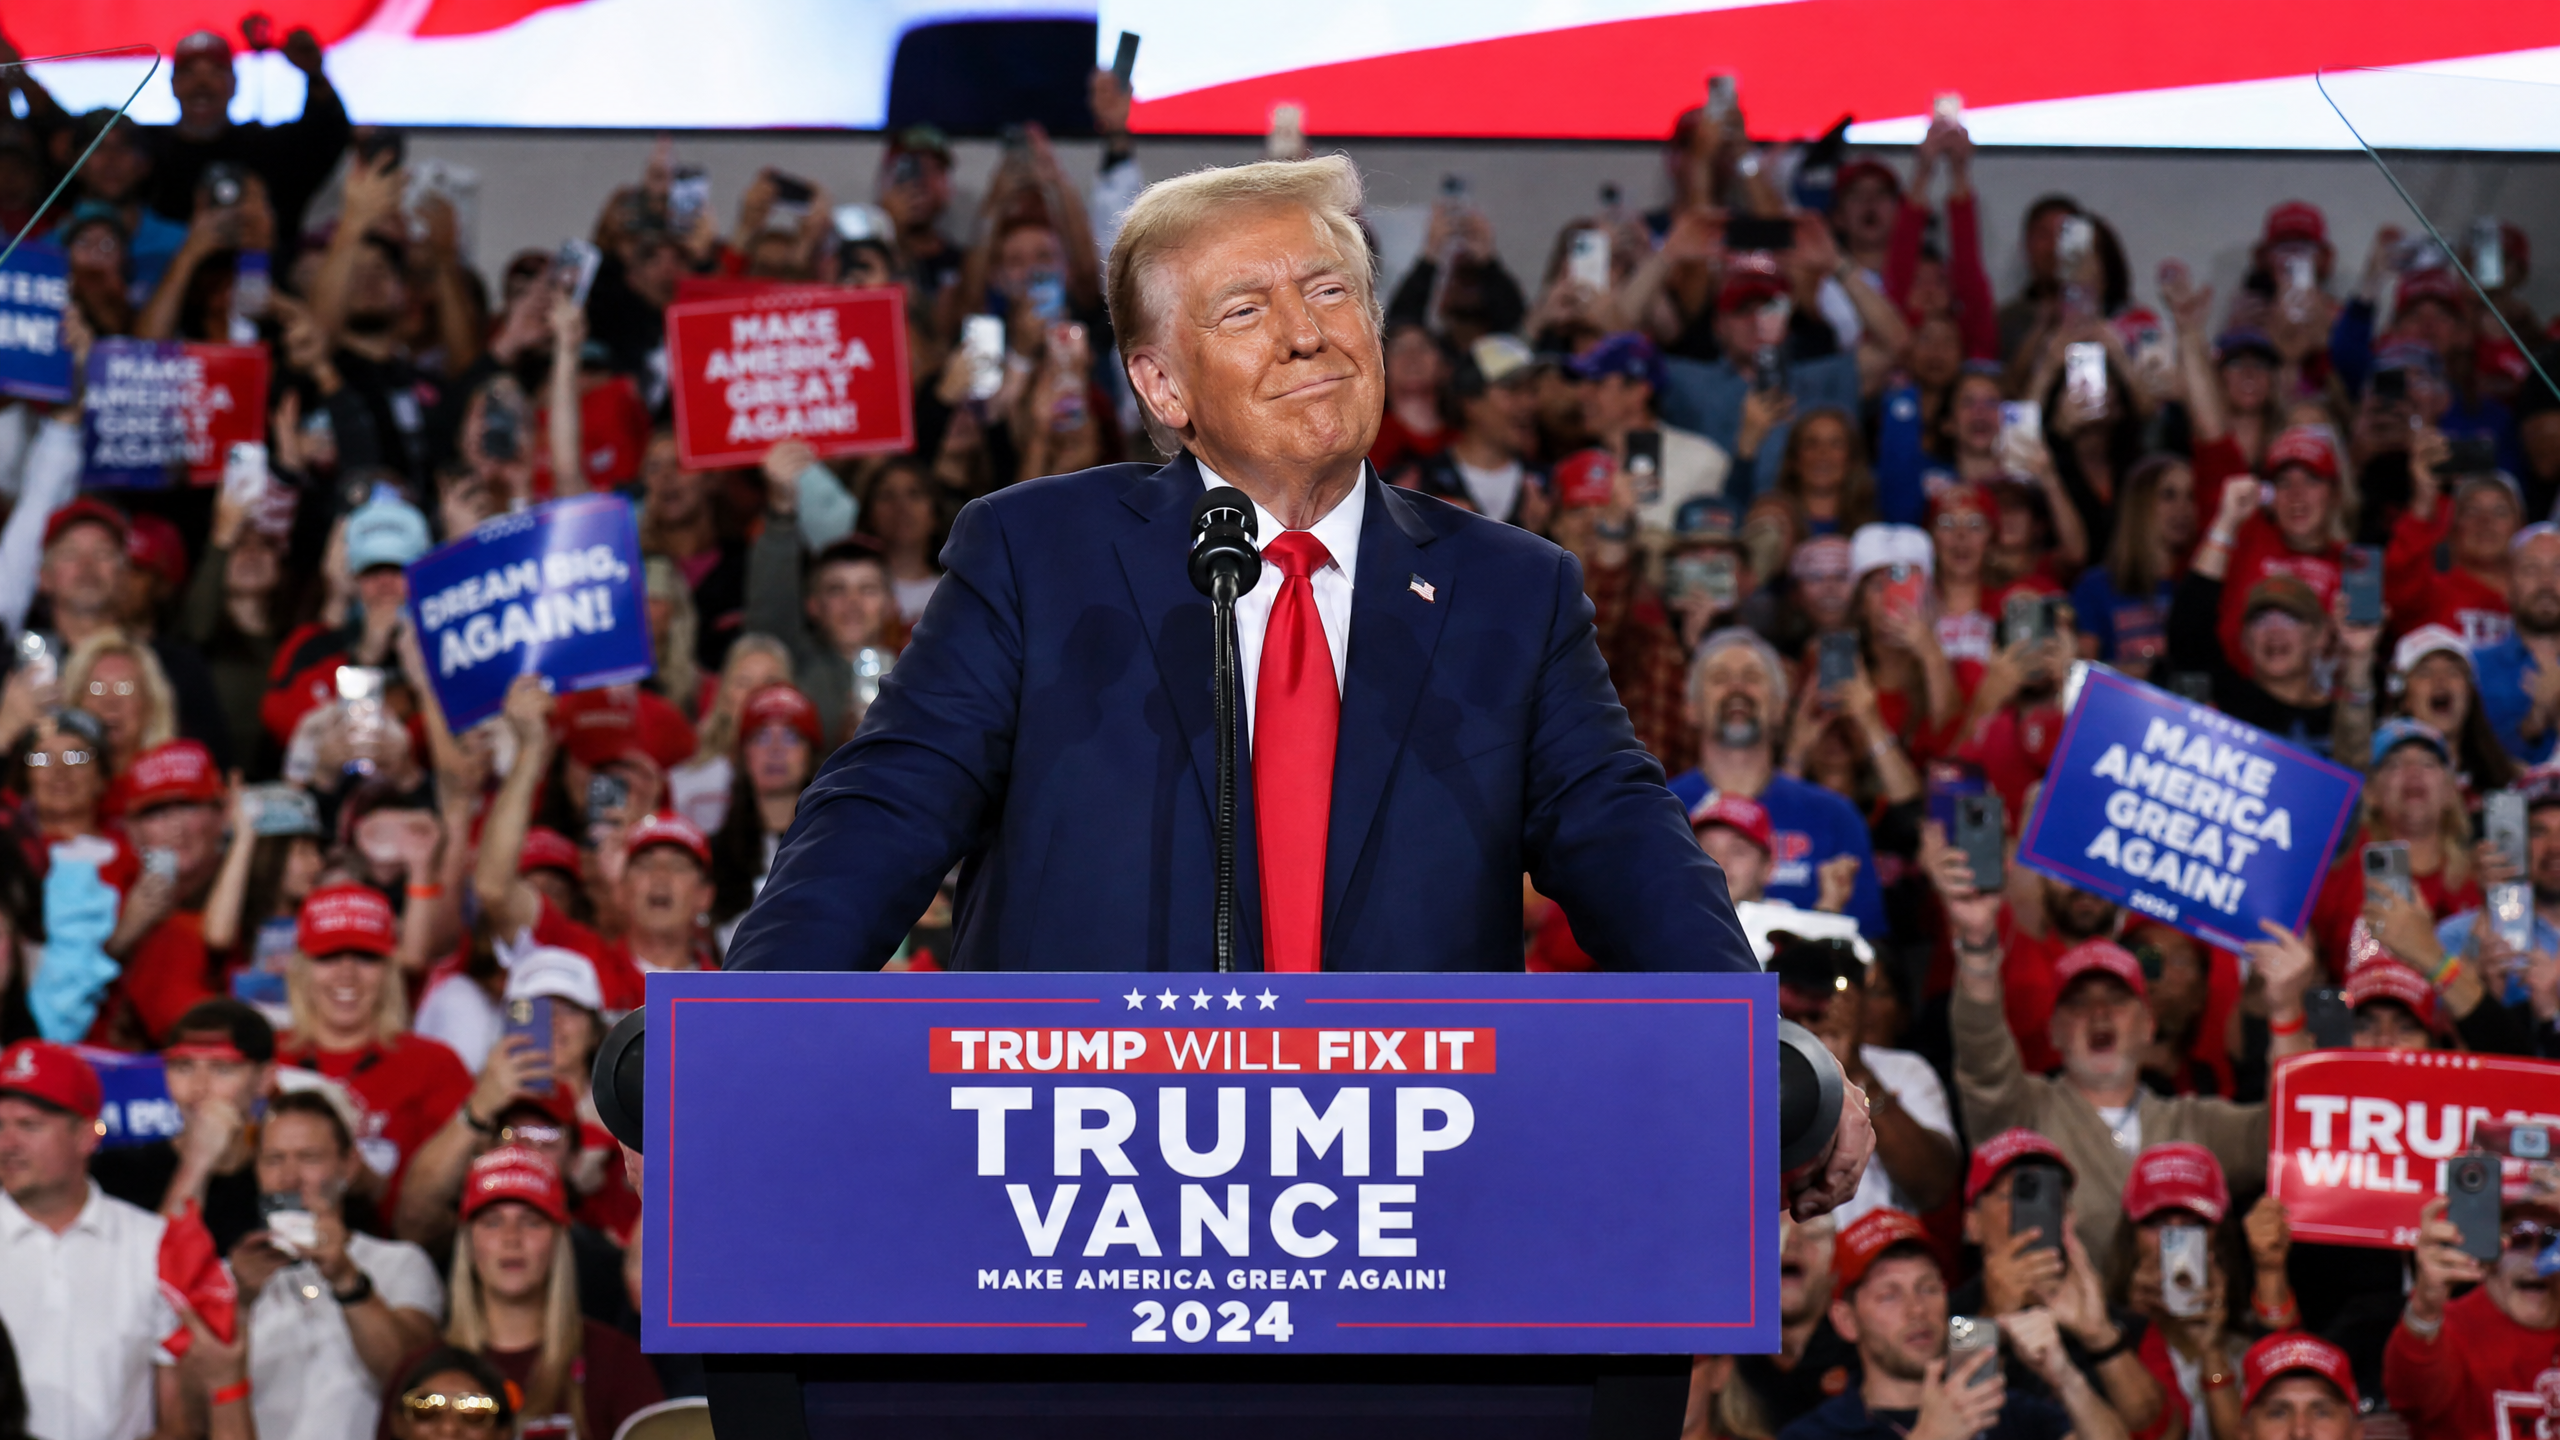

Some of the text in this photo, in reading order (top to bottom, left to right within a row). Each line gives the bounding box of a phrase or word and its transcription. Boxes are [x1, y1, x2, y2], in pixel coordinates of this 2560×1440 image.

[731, 308, 839, 345] MAKE
[704, 337, 874, 383] AMERICA
[726, 376, 851, 412] GREAT
[728, 403, 858, 443] AGAIN!
[420, 544, 629, 632] DREAM BIG,
[440, 585, 615, 679] AGAIN!
[2142, 716, 2277, 798] MAKE
[2091, 743, 2293, 851] AMERICA
[2105, 789, 2260, 884] GREAT
[2085, 826, 2247, 915] AGAIN!
[2129, 889, 2179, 922] 2024
[950, 1030, 1475, 1071] TRUMP WILL FIX IT
[950, 1086, 1475, 1178] TRUMP
[2297, 1147, 2422, 1194] WILL
[1005, 1182, 1417, 1258] VANCE
[977, 1268, 1446, 1290] MAKE AMERICA GREAT AGAIN!
[1131, 1300, 1294, 1343] 2024
